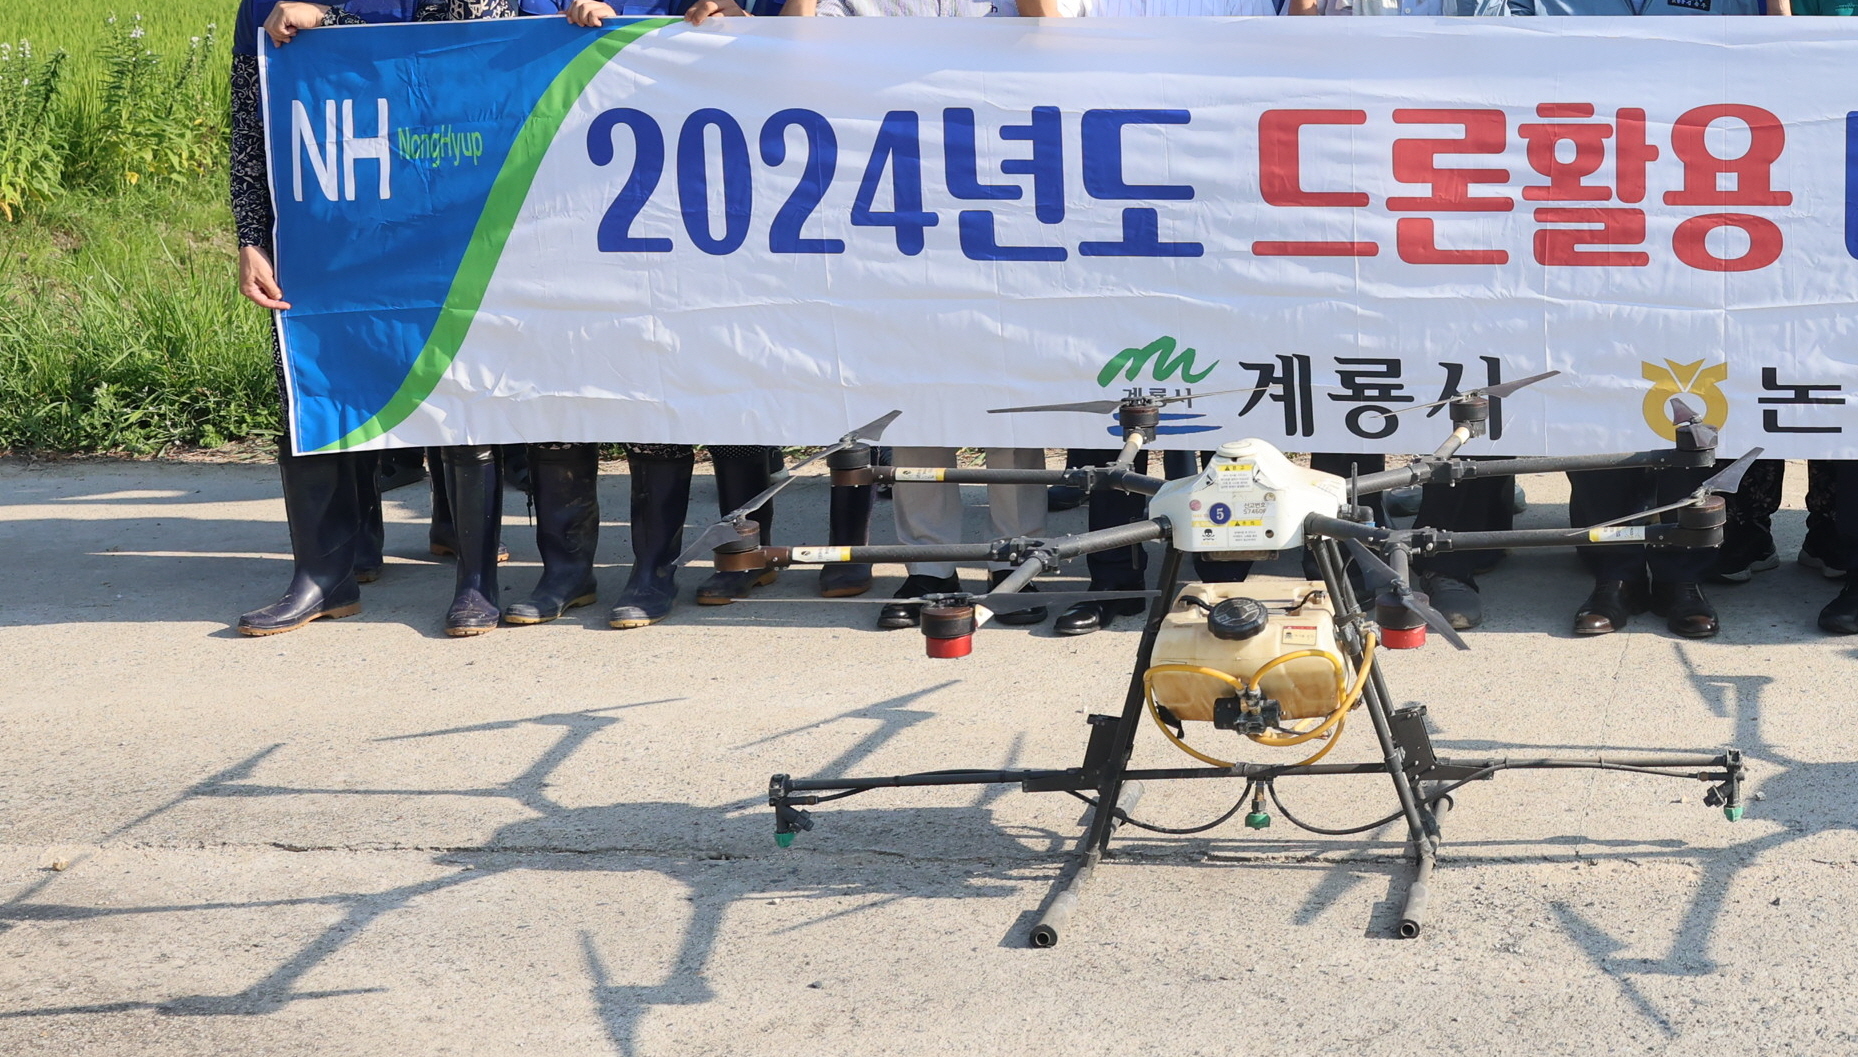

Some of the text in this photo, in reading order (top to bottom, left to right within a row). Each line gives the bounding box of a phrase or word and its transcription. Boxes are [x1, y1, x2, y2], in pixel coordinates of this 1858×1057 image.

[291, 97, 484, 202] NH NongHyup
[586, 106, 1205, 262] 2024년도
[1251, 102, 1793, 272] 드론활용
[1238, 353, 1502, 441] 계룡시
[1216, 507, 1225, 520] 5
